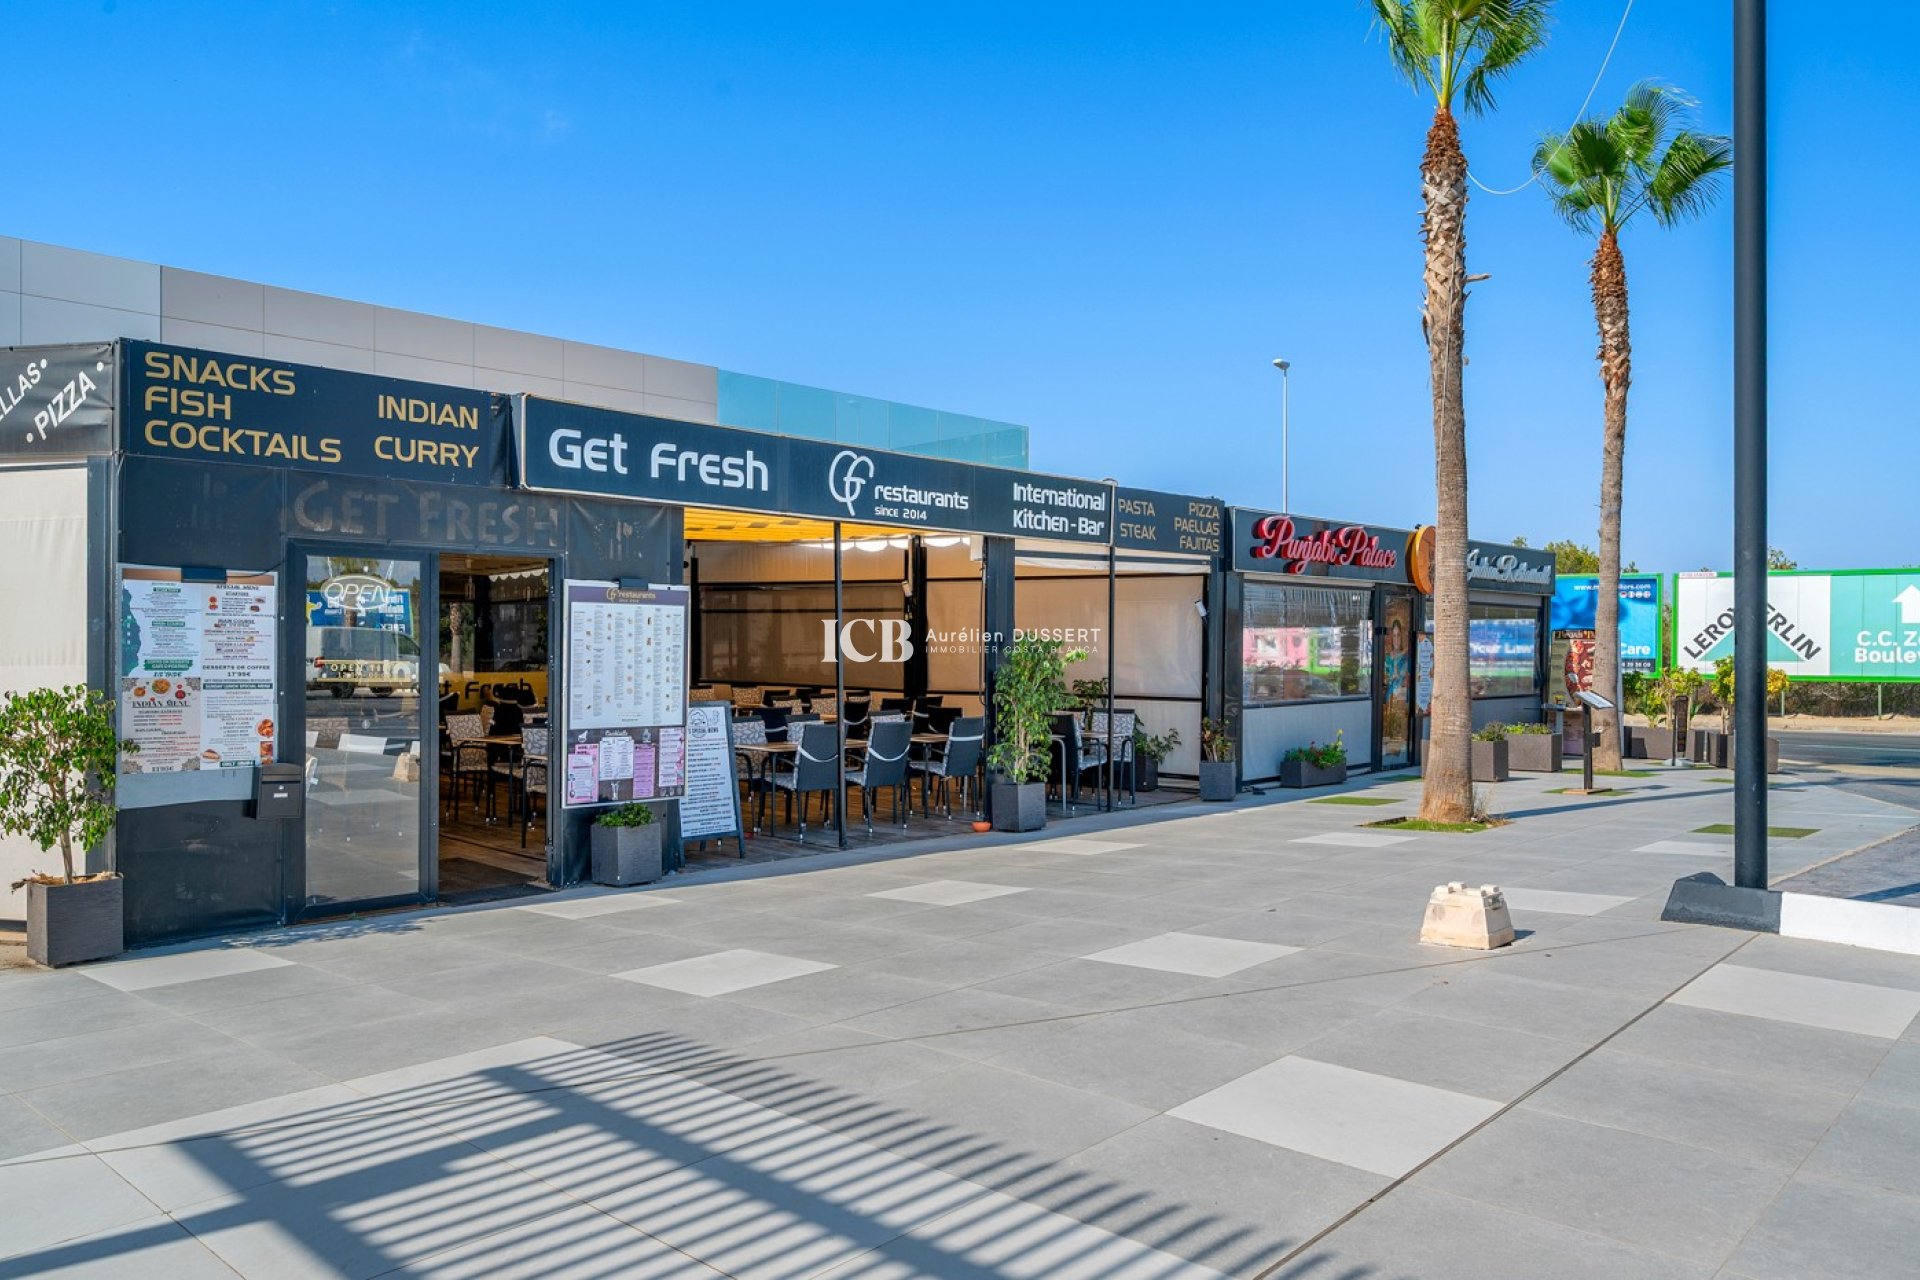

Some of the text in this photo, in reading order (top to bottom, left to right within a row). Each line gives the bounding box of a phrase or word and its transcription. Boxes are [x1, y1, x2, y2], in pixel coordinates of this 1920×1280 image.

[145, 351, 297, 396] SNACKS
[0, 362, 41, 421] LLAS
[34, 370, 97, 441] PIZZA
[144, 385, 231, 421] FISH
[378, 394, 479, 430] INDIAN
[144, 420, 342, 463] COCKTAILS
[374, 435, 480, 468] CURRY
[549, 428, 769, 492] Get Fresh
[874, 484, 969, 511] restaurants
[1012, 482, 1106, 512] International
[1118, 498, 1156, 517] PASTA
[1188, 502, 1220, 519] PIZZA
[294, 480, 558, 547] GET FRESH
[874, 505, 927, 521] since 2014
[1174, 516, 1220, 536] PAELLAS
[1120, 522, 1156, 540] STEAK
[1179, 535, 1220, 552] FAJITAS
[1256, 515, 1398, 575] Punjabi Palace
[323, 582, 392, 606] OPEN
[1856, 630, 1920, 647] C.C. Z
[1854, 646, 1920, 664] Boule
